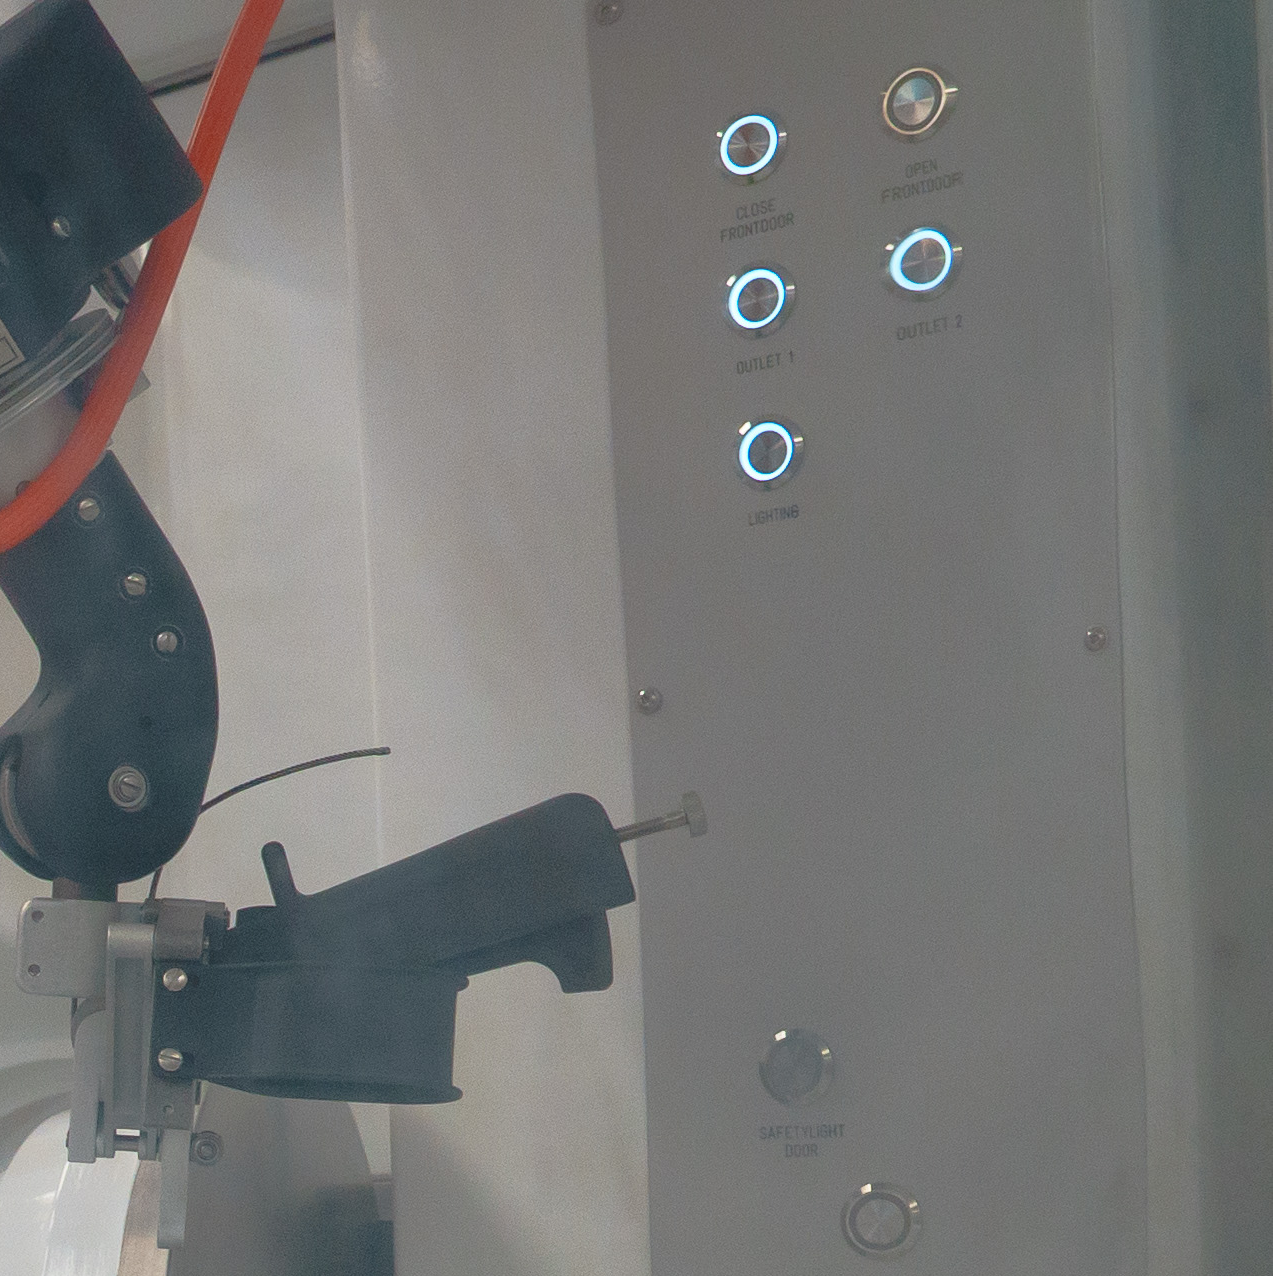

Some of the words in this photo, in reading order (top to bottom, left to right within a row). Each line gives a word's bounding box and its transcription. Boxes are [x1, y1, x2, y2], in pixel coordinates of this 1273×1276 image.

[905, 159, 938, 178] OPEN
[881, 170, 964, 202] FRONTDOOR
[736, 198, 775, 220] CLOSE
[720, 212, 795, 242] FRONTDOOR
[896, 316, 947, 340] OUTLET
[955, 314, 963, 328] 2
[736, 352, 782, 374] OUTLET
[748, 504, 799, 526] LIGHTING
[760, 1123, 845, 1140] SAFETYLIGHT
[785, 1144, 819, 1158] DOOR
